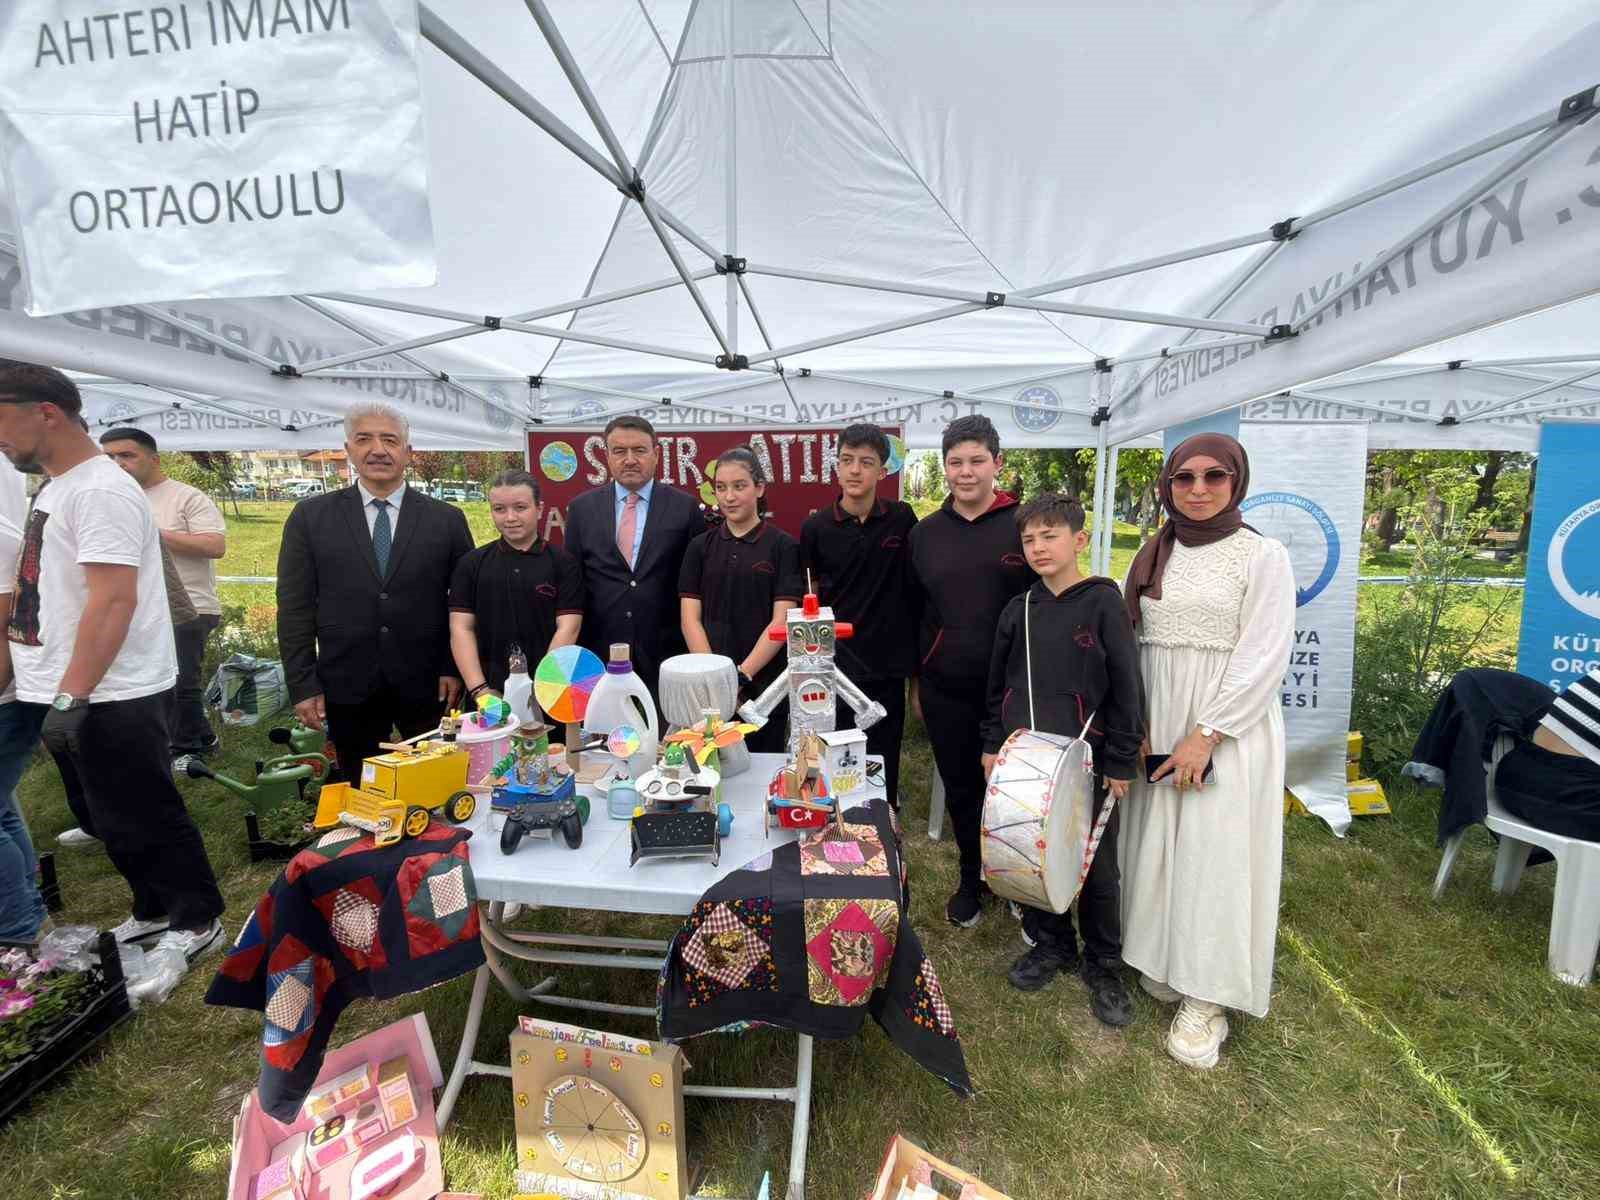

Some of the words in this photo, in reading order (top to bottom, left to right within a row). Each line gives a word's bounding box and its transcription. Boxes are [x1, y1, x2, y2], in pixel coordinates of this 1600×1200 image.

[133, 80, 260, 144] HATİP
[69, 168, 346, 234] ORTAOKULU
[583, 435, 704, 486] SIR
